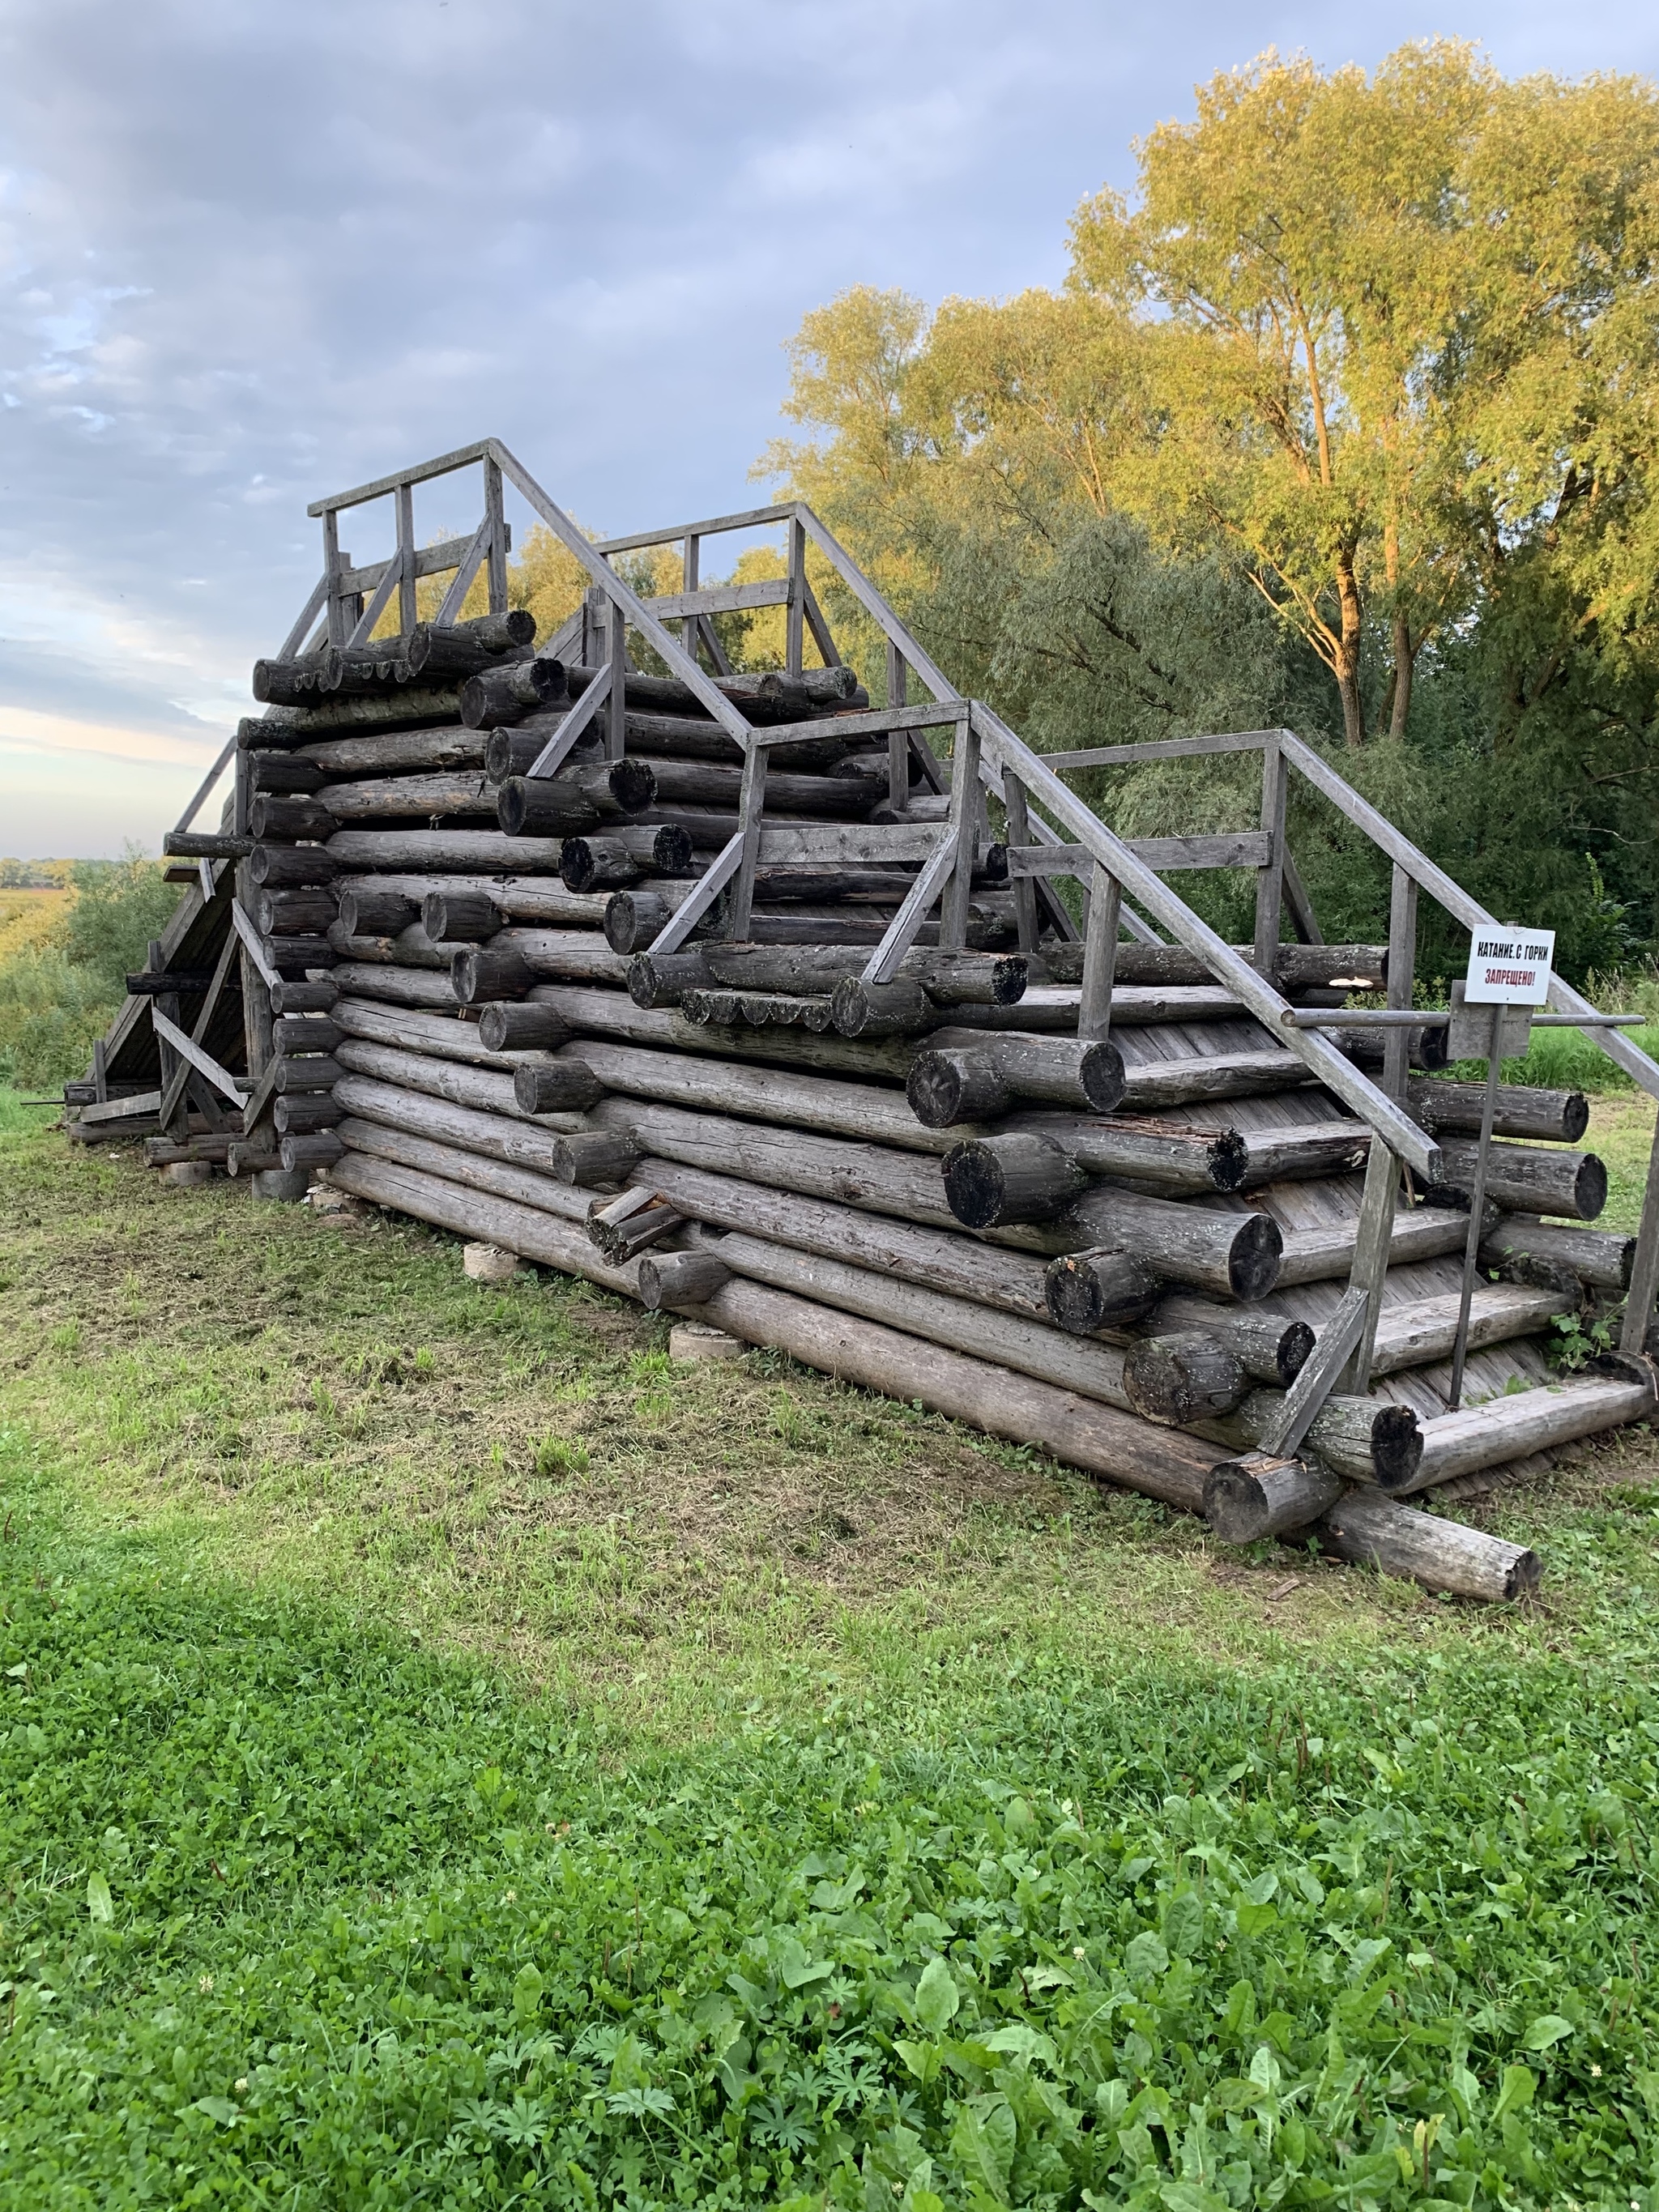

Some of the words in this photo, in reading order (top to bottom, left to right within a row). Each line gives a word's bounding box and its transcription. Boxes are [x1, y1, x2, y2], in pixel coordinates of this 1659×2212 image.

[1516, 944, 1522, 960] С
[1524, 944, 1549, 961] ГОРКИ
[1485, 968, 1536, 987] ЗАПРЕЩЕНО!
